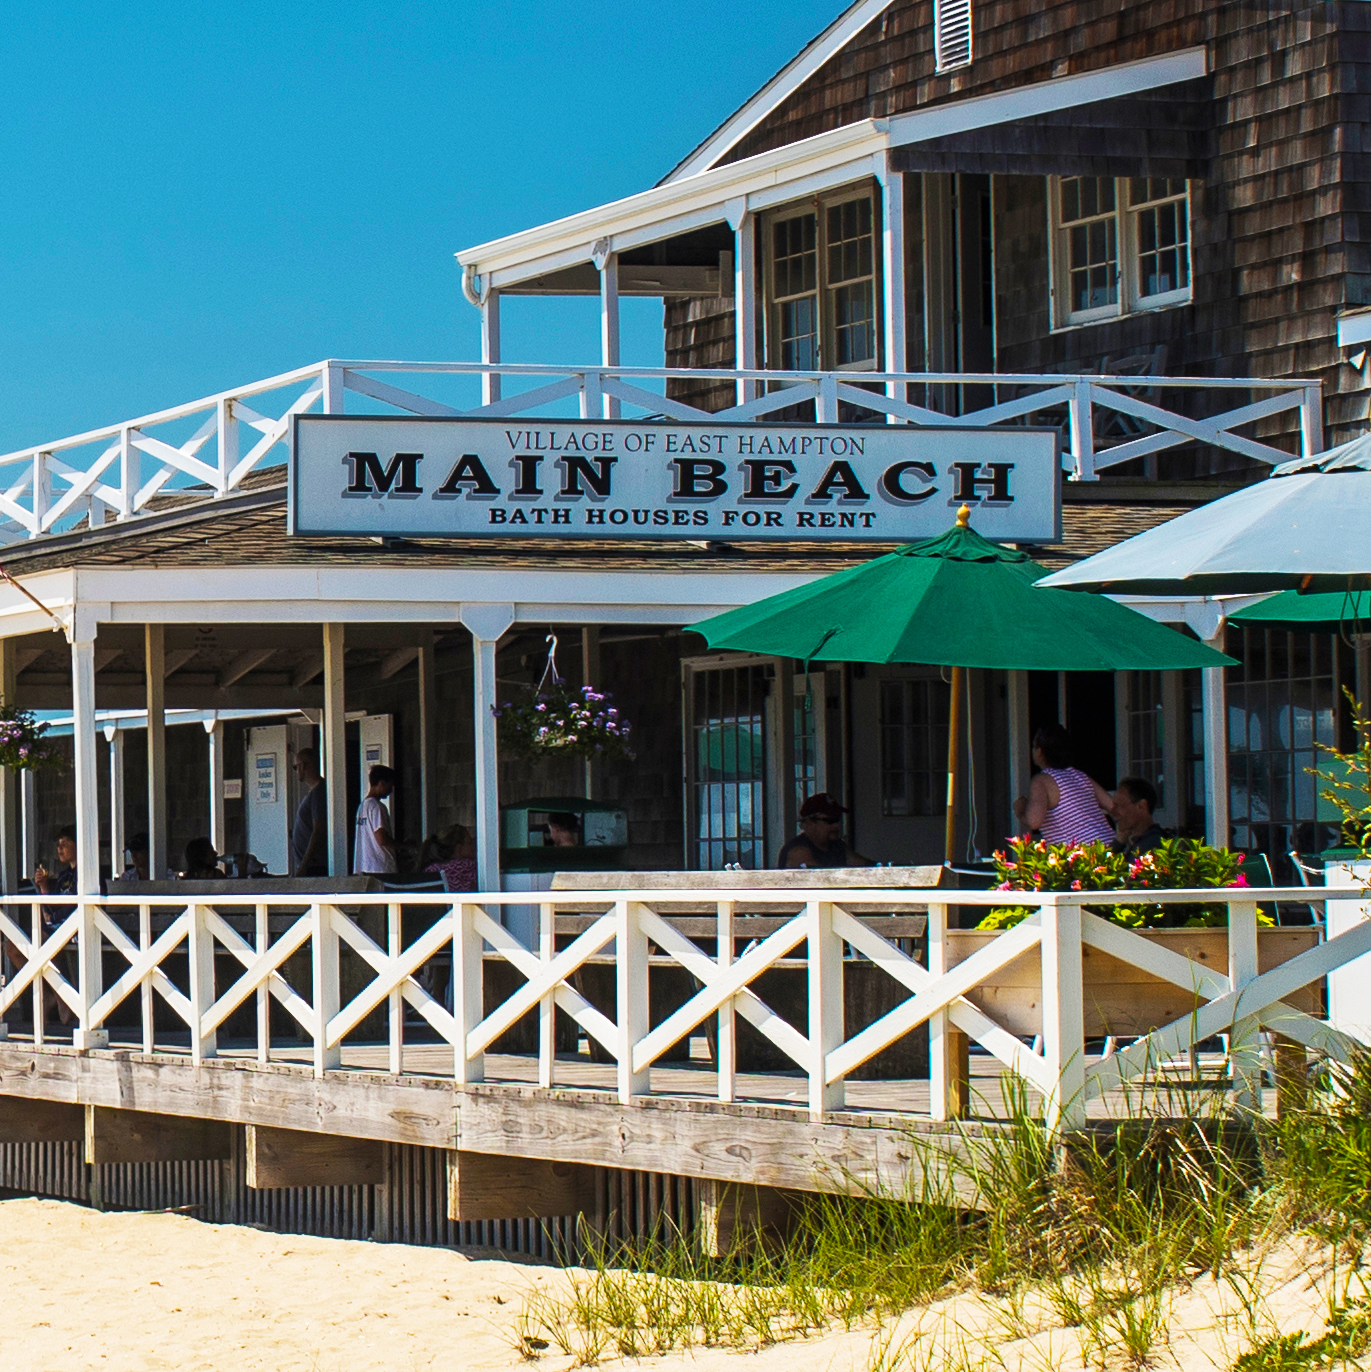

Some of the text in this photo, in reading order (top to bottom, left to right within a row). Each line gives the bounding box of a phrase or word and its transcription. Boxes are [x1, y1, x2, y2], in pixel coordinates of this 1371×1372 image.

[505, 430, 867, 456] VILLAGE OF EAST HAMPTON
[341, 451, 1015, 507] MAIN BEACH
[488, 507, 877, 529] BATH HOUSES FOR RENT
